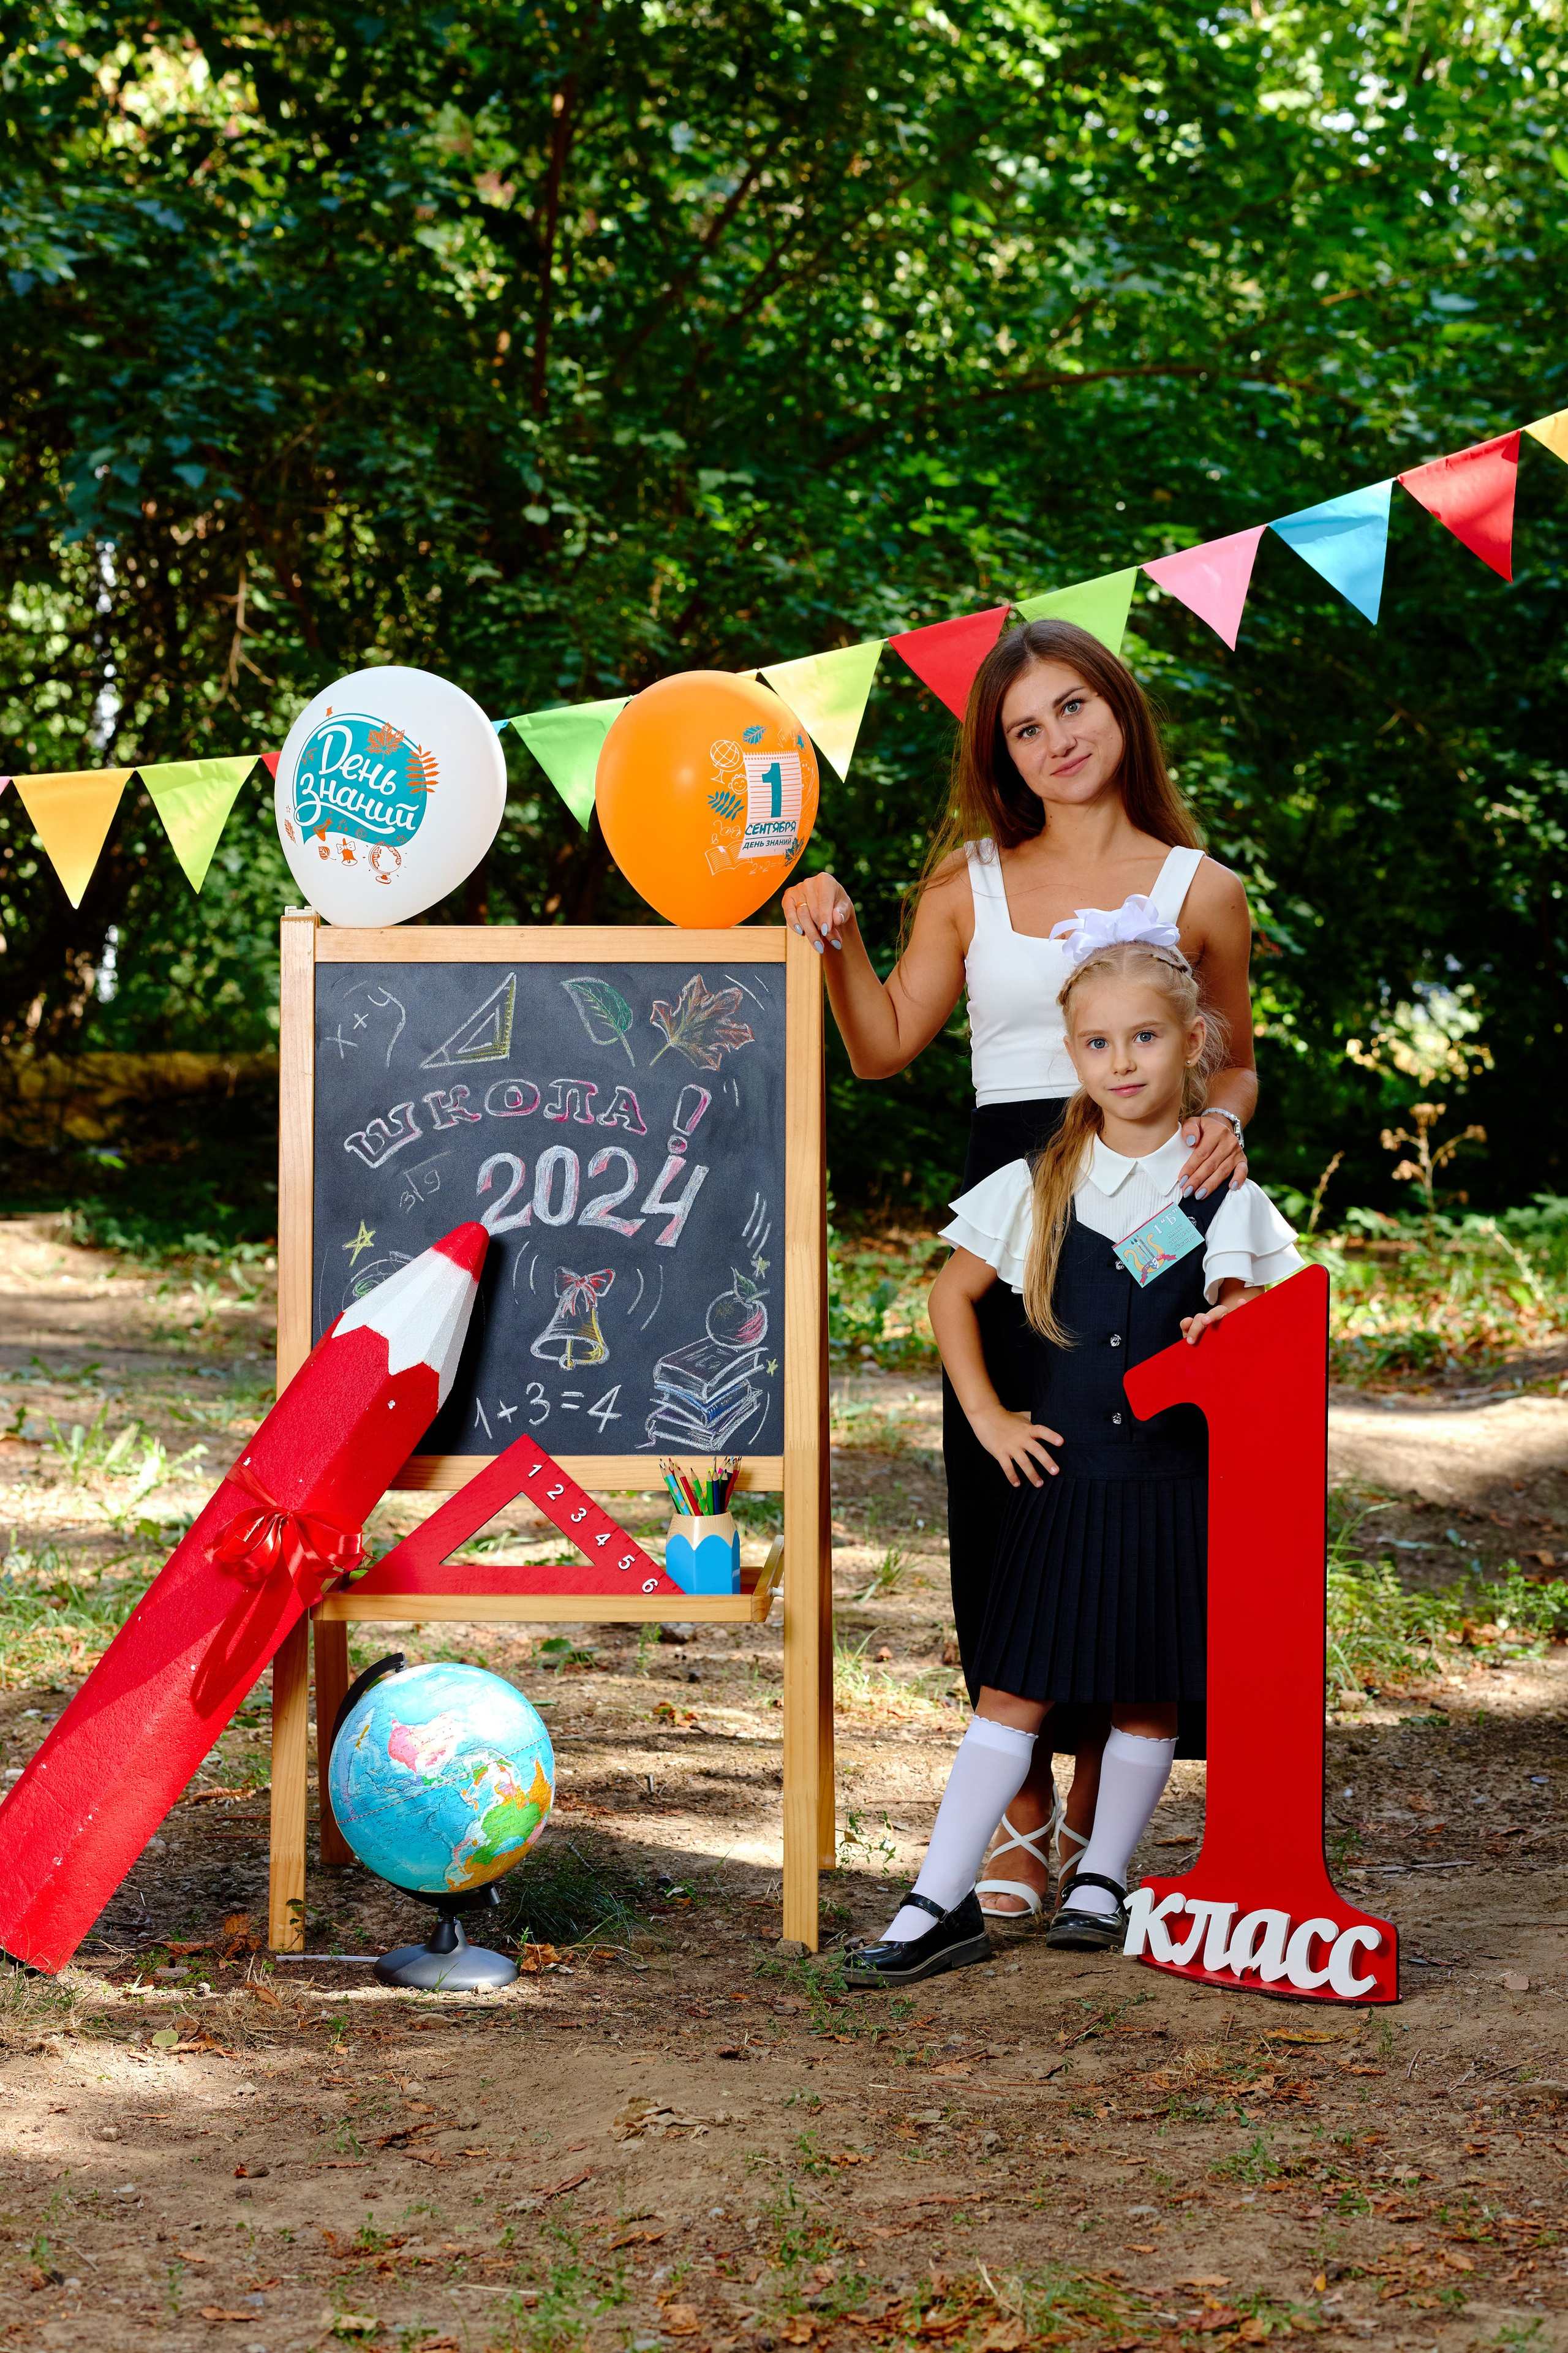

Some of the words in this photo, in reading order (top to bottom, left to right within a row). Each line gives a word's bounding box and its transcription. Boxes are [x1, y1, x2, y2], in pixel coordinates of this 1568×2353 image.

[317, 724, 398, 796] День
[761, 762, 782, 818] 1
[742, 840, 764, 850] ДЕНЬ
[765, 837, 791, 847] ЗНАНИЙ
[745, 821, 796, 835] СЕНТЯБРЯ
[476, 1145, 710, 1248] 2024
[1154, 1224, 1163, 1235] 1
[527, 1464, 543, 1478] 1
[546, 1483, 565, 1501] 2
[570, 1507, 587, 1524] 3
[594, 1531, 611, 1547] 4
[617, 1554, 636, 1571] 5
[641, 1577, 659, 1593] 6
